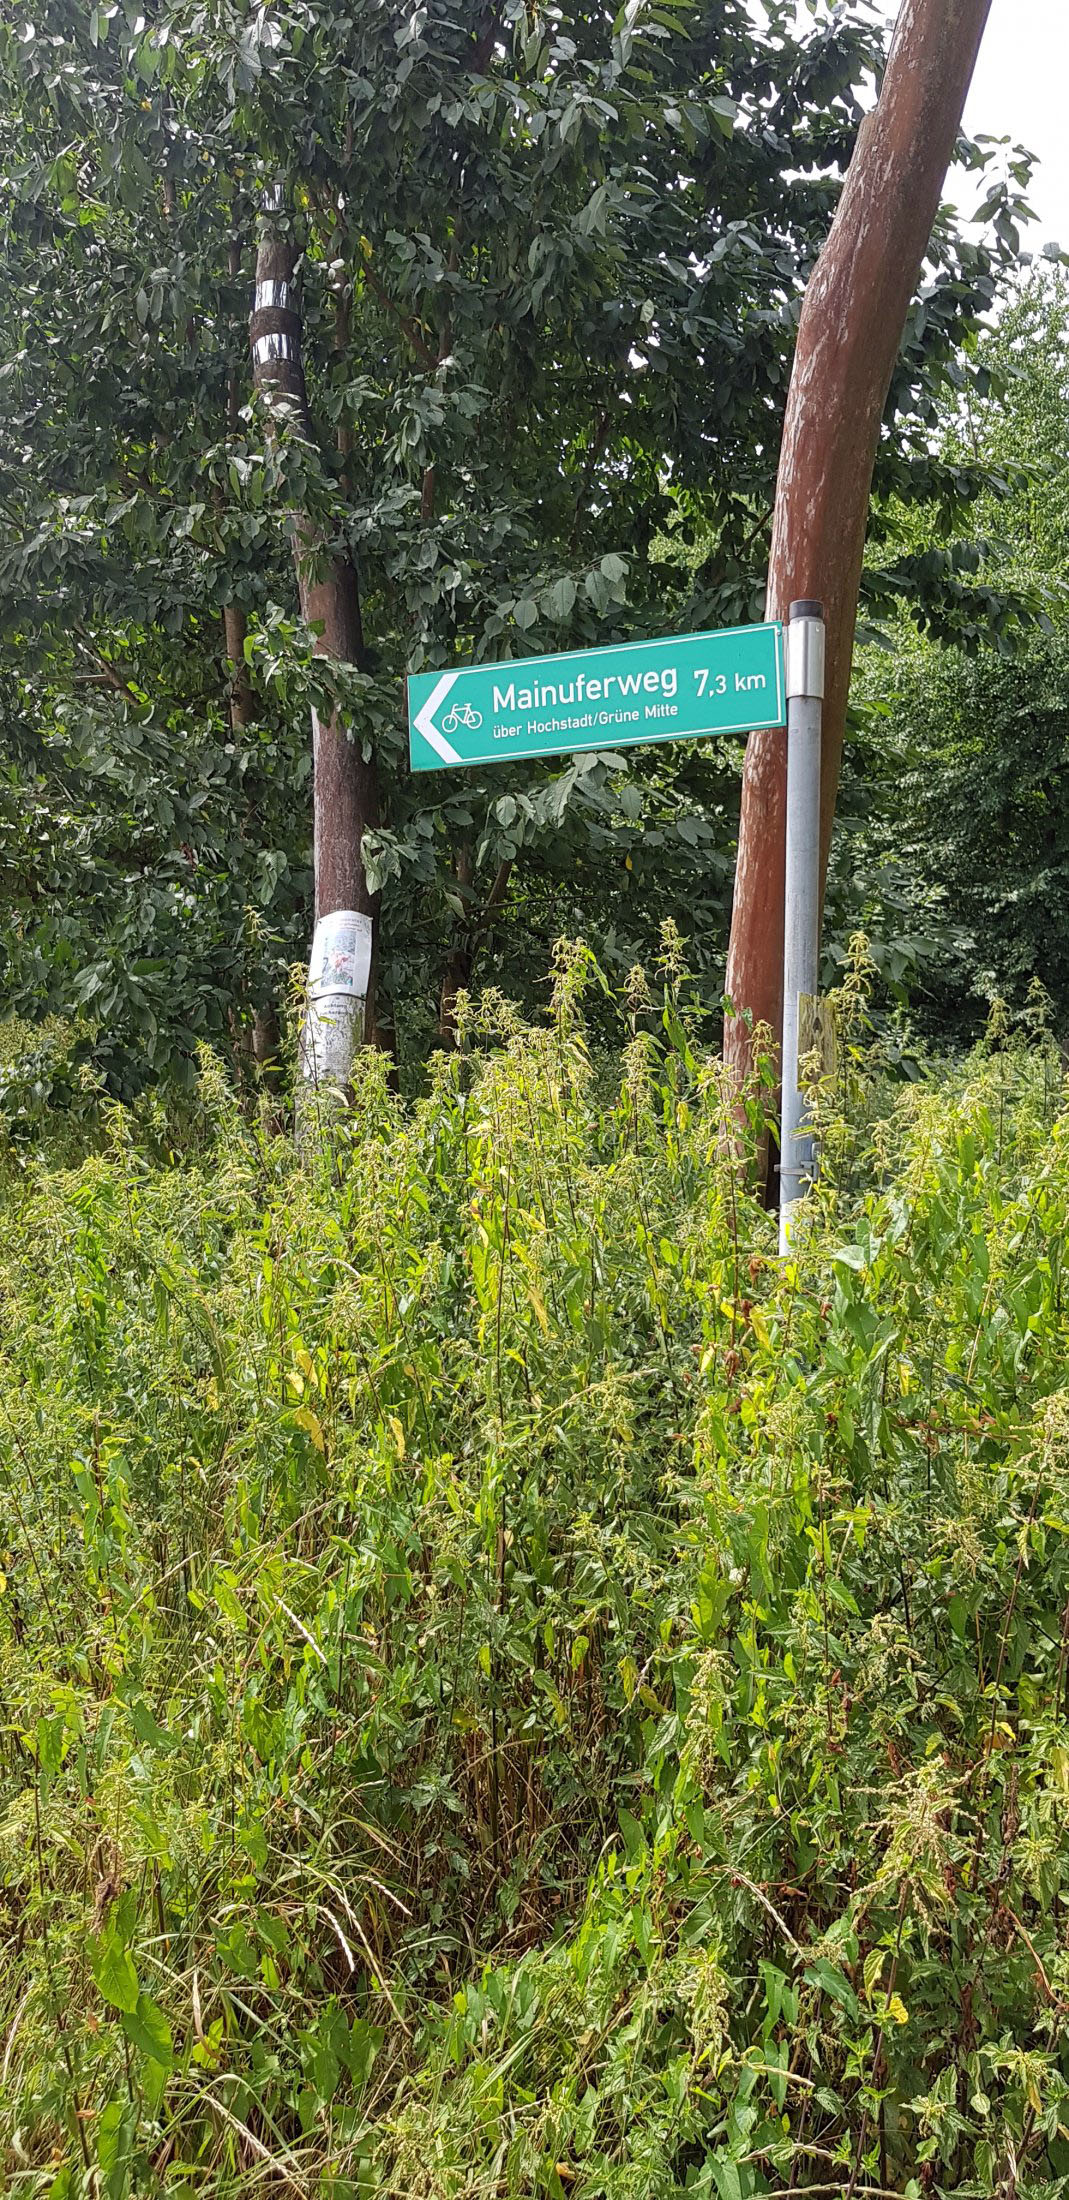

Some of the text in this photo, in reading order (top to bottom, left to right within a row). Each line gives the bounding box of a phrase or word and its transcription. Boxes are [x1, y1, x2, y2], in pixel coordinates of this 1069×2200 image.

[492, 667, 766, 713] Mainuferweg 7,3 km
[493, 703, 678, 739] über Hochstadt/Grüne Mitte
